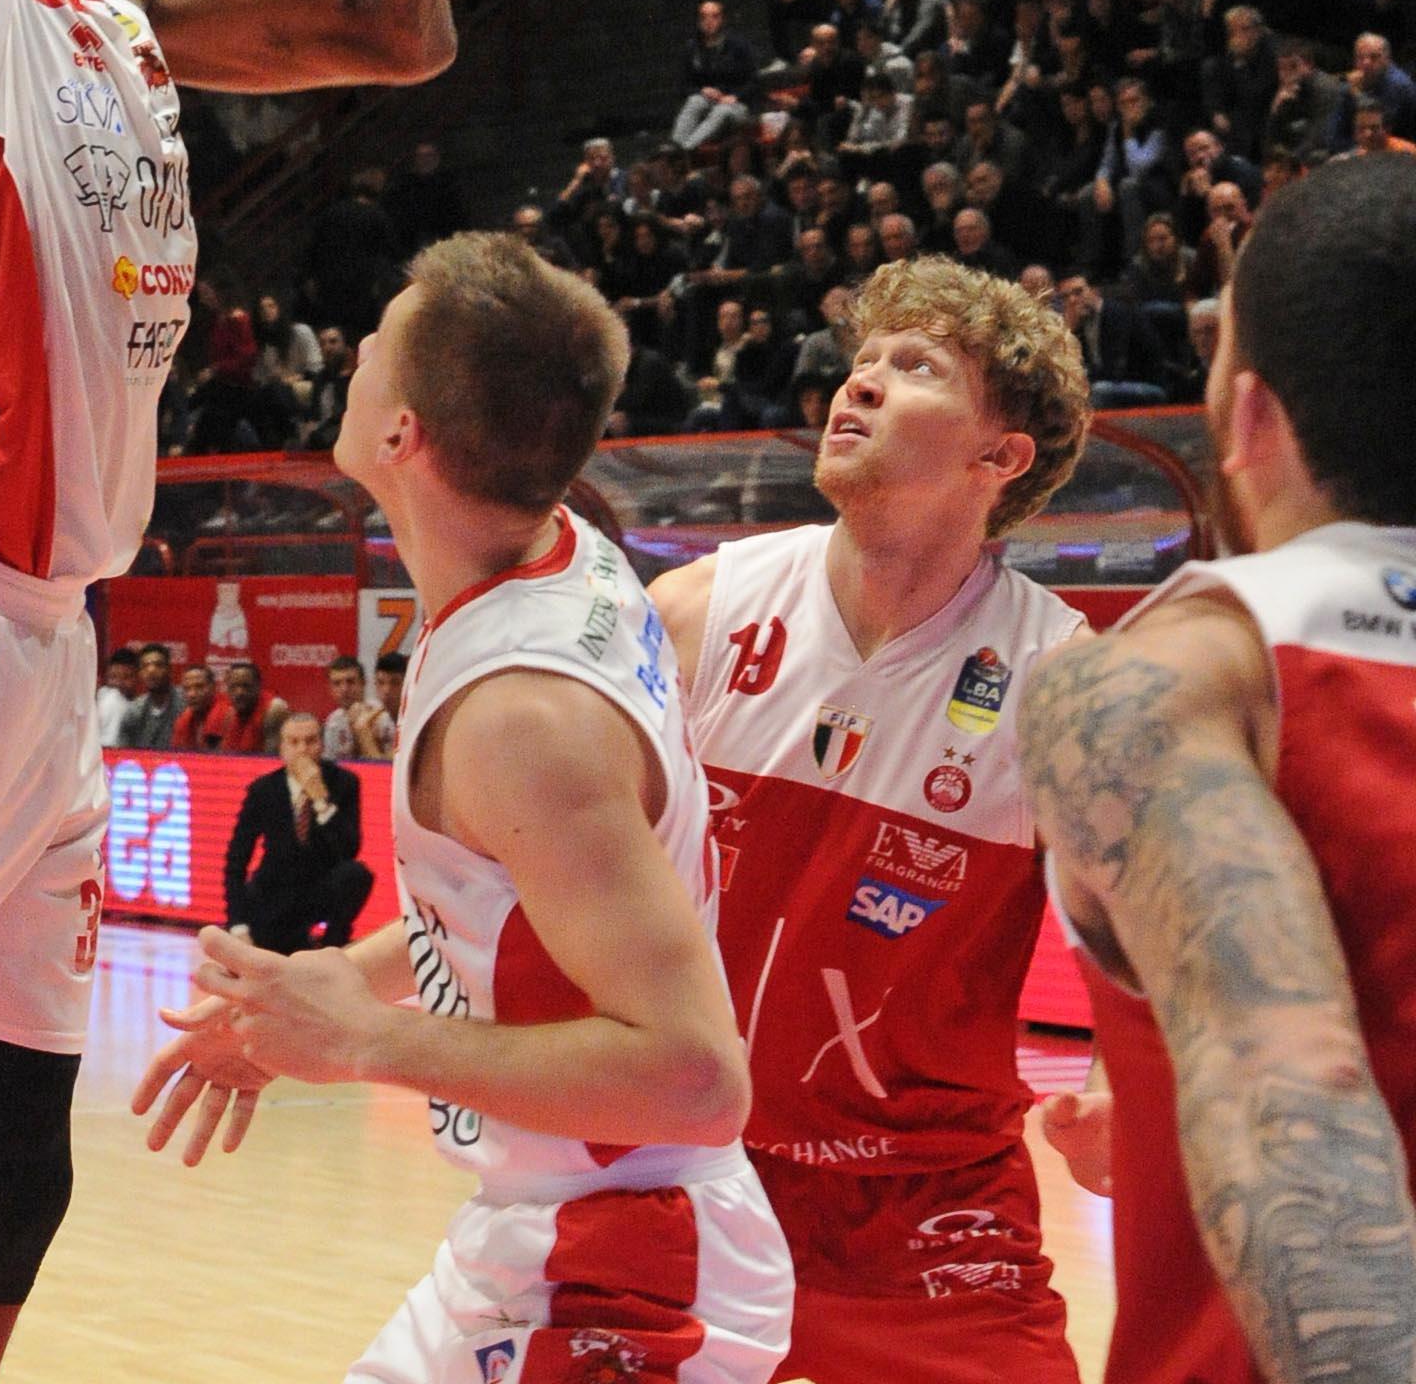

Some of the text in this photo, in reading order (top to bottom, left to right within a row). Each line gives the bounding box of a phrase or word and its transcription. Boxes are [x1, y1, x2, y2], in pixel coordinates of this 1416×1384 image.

[727, 616, 787, 695] 19
[962, 678, 1001, 703] LBA
[110, 759, 192, 907] ea
[865, 854, 962, 892] FRAGRANCES
[849, 884, 926, 935] SAP
